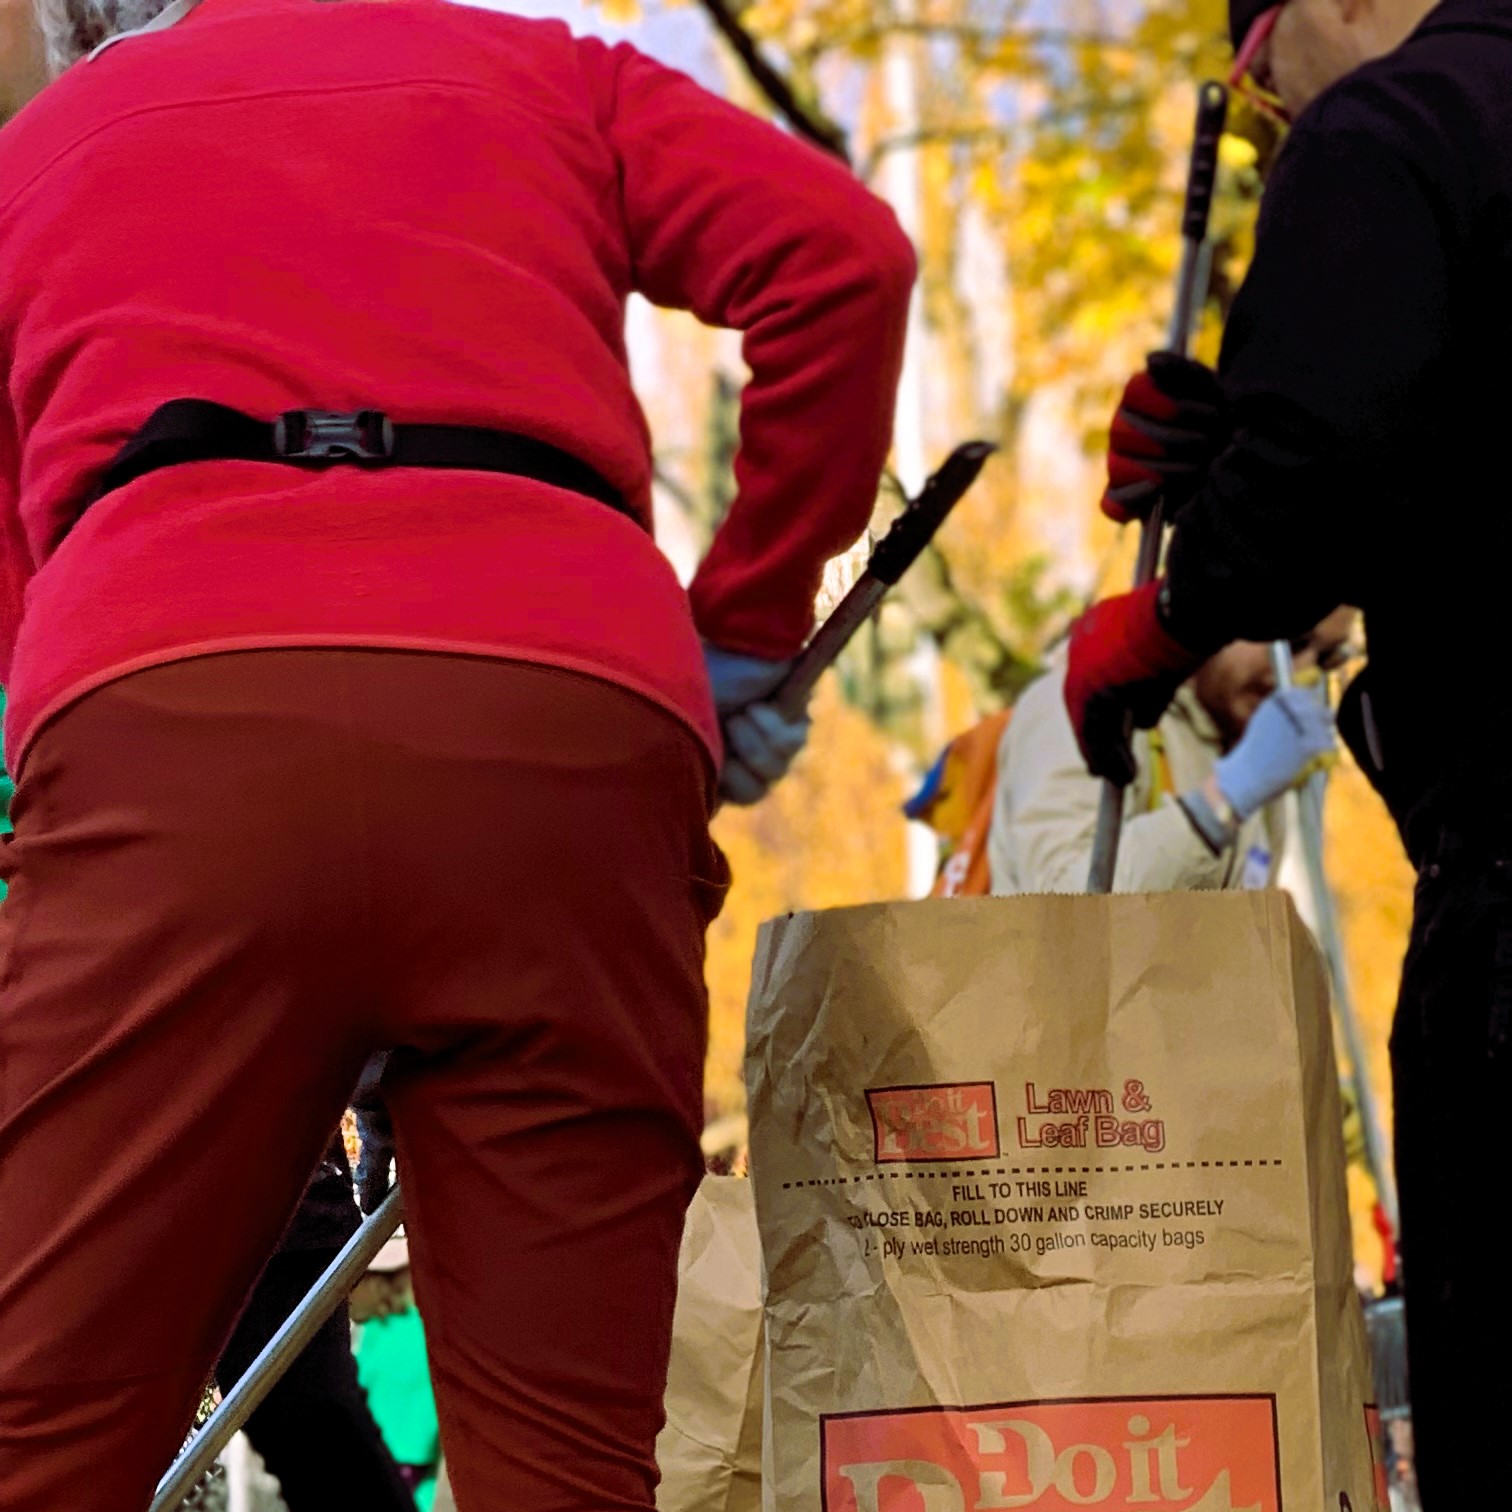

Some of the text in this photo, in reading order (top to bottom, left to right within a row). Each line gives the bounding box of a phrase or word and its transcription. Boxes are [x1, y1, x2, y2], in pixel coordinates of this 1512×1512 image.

[1026, 1078, 1152, 1115] Lawn &
[1016, 1115, 1165, 1153] Leaf Bag
[952, 1181, 1088, 1201] FILL TO THIS LINE
[863, 1211, 910, 1227] CLOSE
[914, 1211, 948, 1229] BAG,
[950, 1209, 991, 1227] ROLL
[994, 1206, 1043, 1224] DOWN
[1047, 1206, 1080, 1222] AND
[1084, 1205, 1134, 1220] CRIMP
[1139, 1200, 1225, 1219] SECURELY
[883, 1237, 905, 1260] ply
[910, 1238, 938, 1255] wet
[942, 1234, 1005, 1259] strength
[1010, 1232, 1031, 1252] 30
[1036, 1232, 1086, 1256] gallon
[1090, 1229, 1157, 1251] capacity
[1162, 1228, 1205, 1249] bags
[966, 1413, 1194, 1510] Do it
